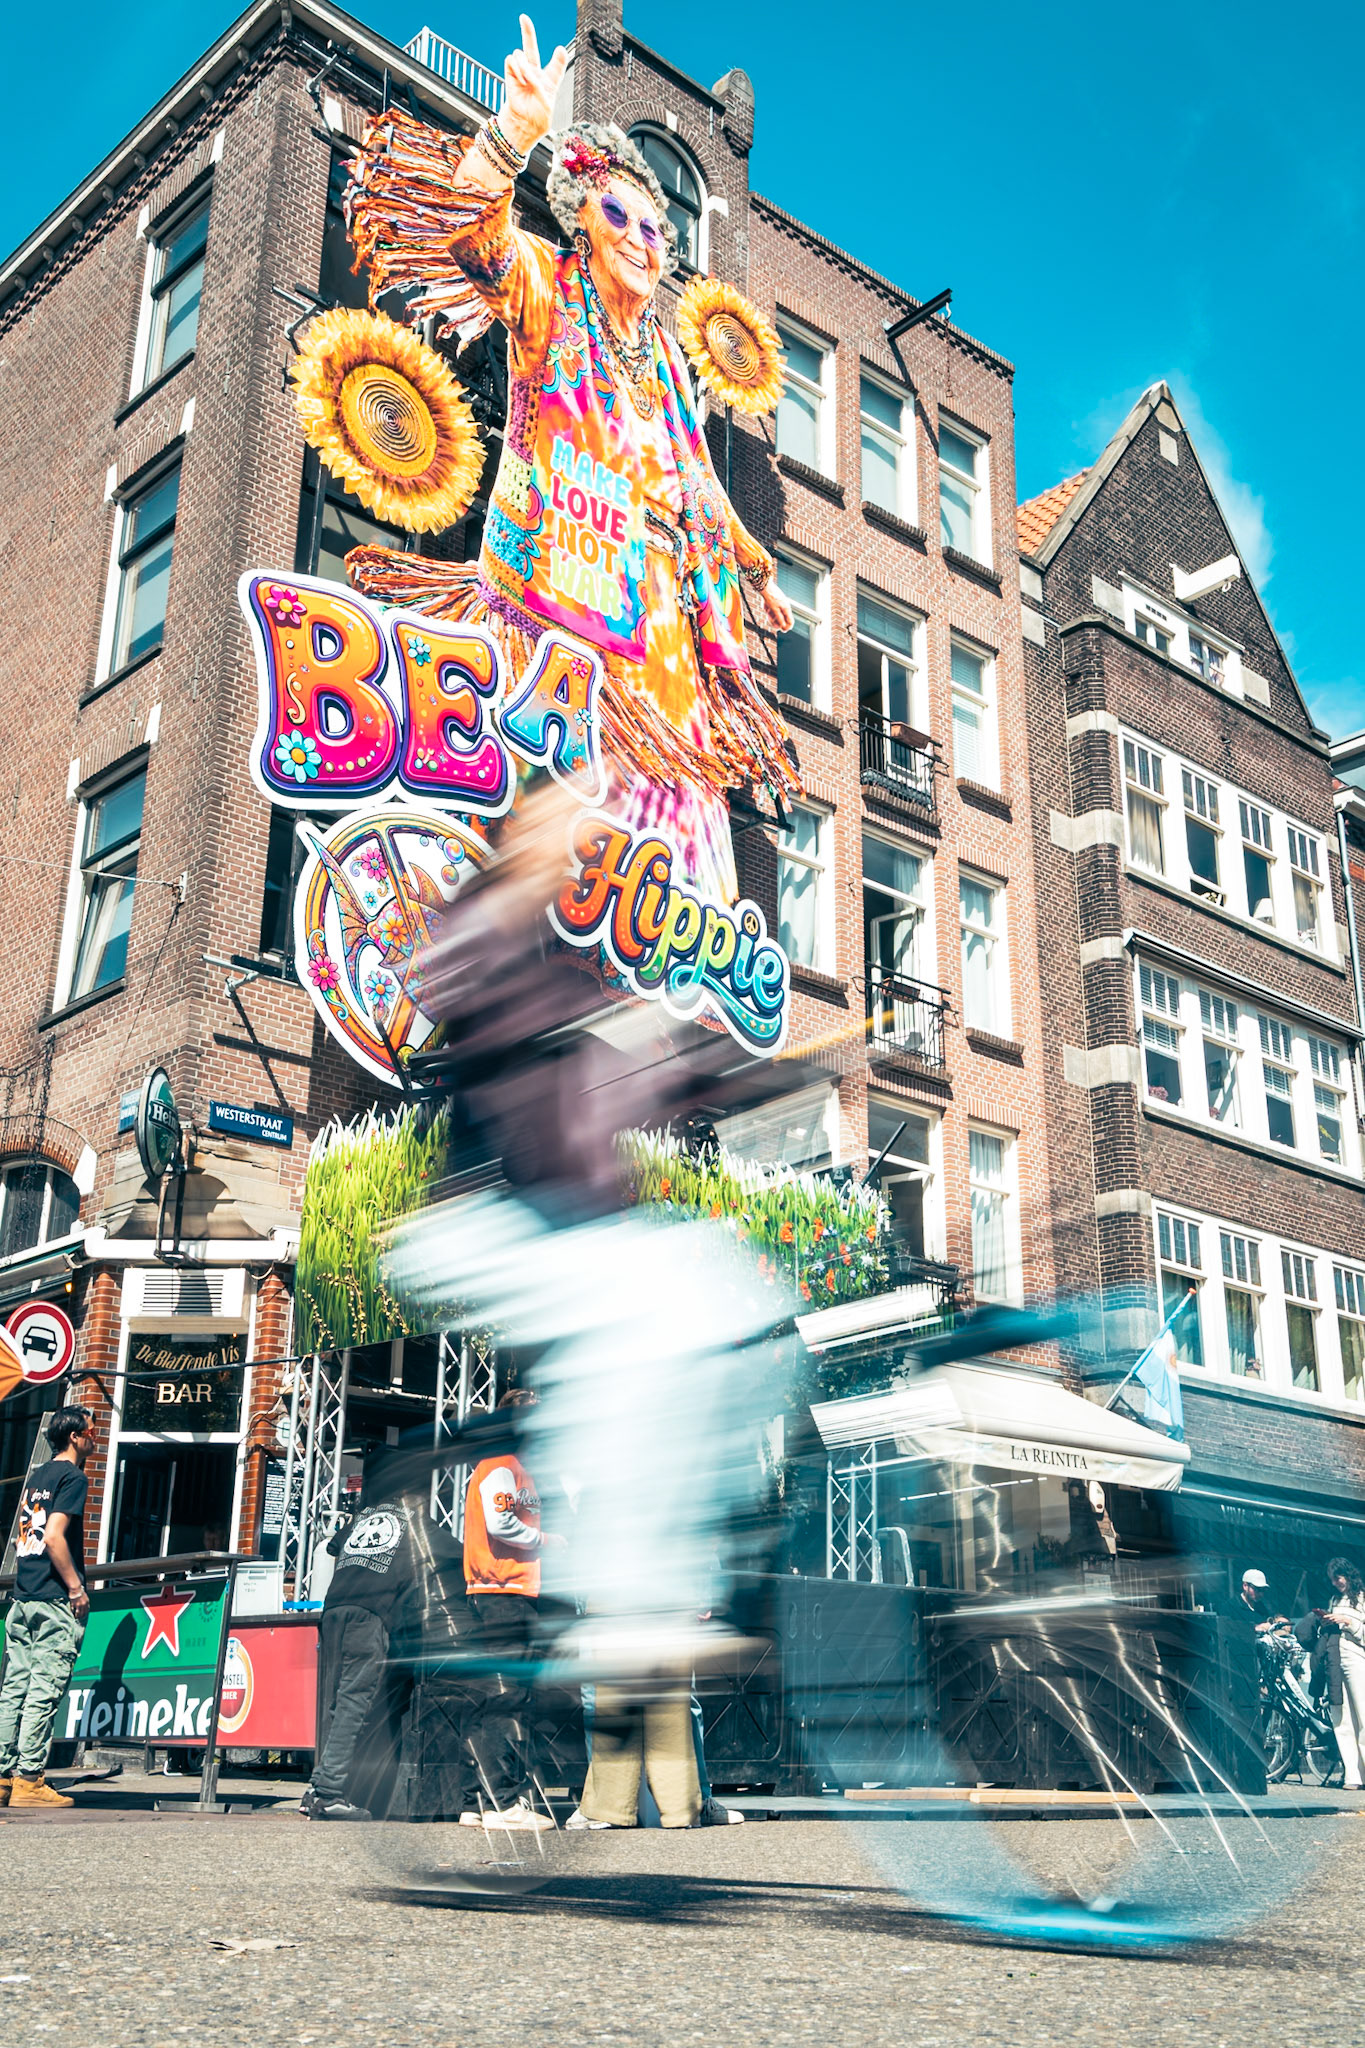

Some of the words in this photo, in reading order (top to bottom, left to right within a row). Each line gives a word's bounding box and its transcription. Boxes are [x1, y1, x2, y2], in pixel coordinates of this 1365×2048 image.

[550, 436, 632, 507] MAKE
[551, 475, 628, 544] LOVE
[556, 519, 619, 575] NOT
[550, 548, 622, 620] WAR
[247, 575, 602, 804] BEA
[554, 816, 786, 1048] Hippie
[151, 1103, 177, 1130] Hein
[215, 1105, 284, 1131] WESTERSTRAAT
[261, 1129, 288, 1142] CENTRUM
[135, 1344, 156, 1364] De
[153, 1349, 219, 1371] Blaffende
[221, 1345, 240, 1365] Vis
[157, 1382, 213, 1404] BAR
[1010, 1445, 1029, 1462] LA
[1032, 1447, 1088, 1470] REINITA
[223, 1674, 244, 1686] MSTEL
[222, 1691, 238, 1700] BIER
[65, 1684, 214, 1738] Heineke
